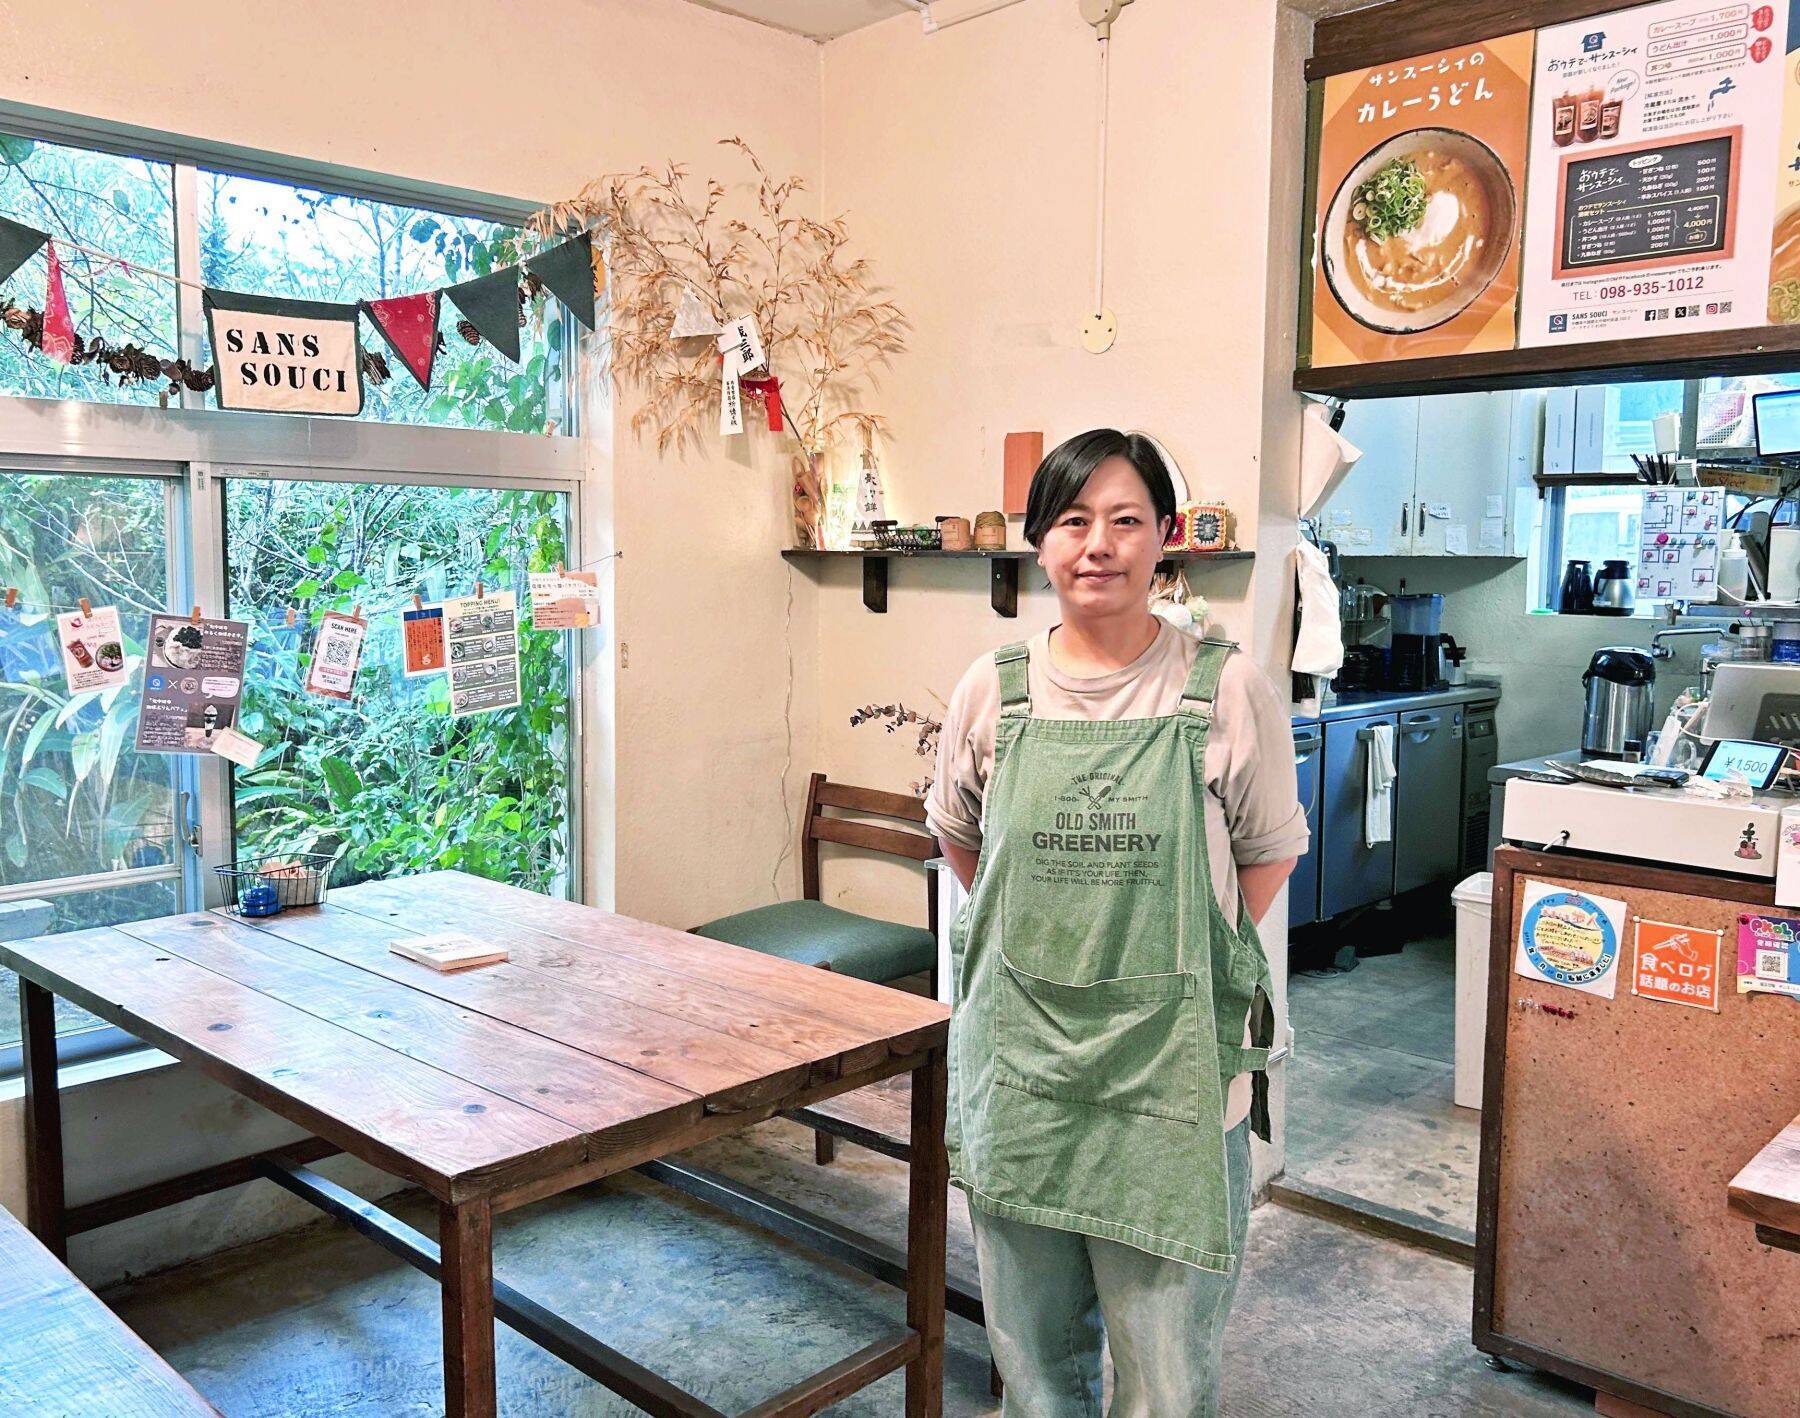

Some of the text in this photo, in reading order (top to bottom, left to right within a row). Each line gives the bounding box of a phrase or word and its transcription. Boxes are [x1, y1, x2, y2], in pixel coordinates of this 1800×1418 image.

[1369, 51, 1485, 87] サンスーシィの
[1357, 77, 1494, 124] カレーうどん
[1683, 218, 1713, 229] 4,000円
[1600, 276, 1705, 300] 098-935-1012
[1572, 312, 1588, 320] SANS
[1589, 310, 1608, 318] SOUCI
[226, 328, 320, 358] SANS
[240, 362, 347, 393] SOUCI
[331, 623, 344, 631] SCAN
[1072, 772, 1121, 785] THE ORIGINAL
[1055, 812, 1136, 831] OLD SMITH
[1032, 831, 1162, 853] GREENERY
[1036, 858, 1049, 866] DIG
[1051, 859, 1066, 867] THE
[1133, 860, 1159, 868] SEEDS
[1031, 874, 1052, 882] YOUR
[1639, 952, 1712, 981] 食べログ
[1639, 973, 1711, 999] 話題のお店
